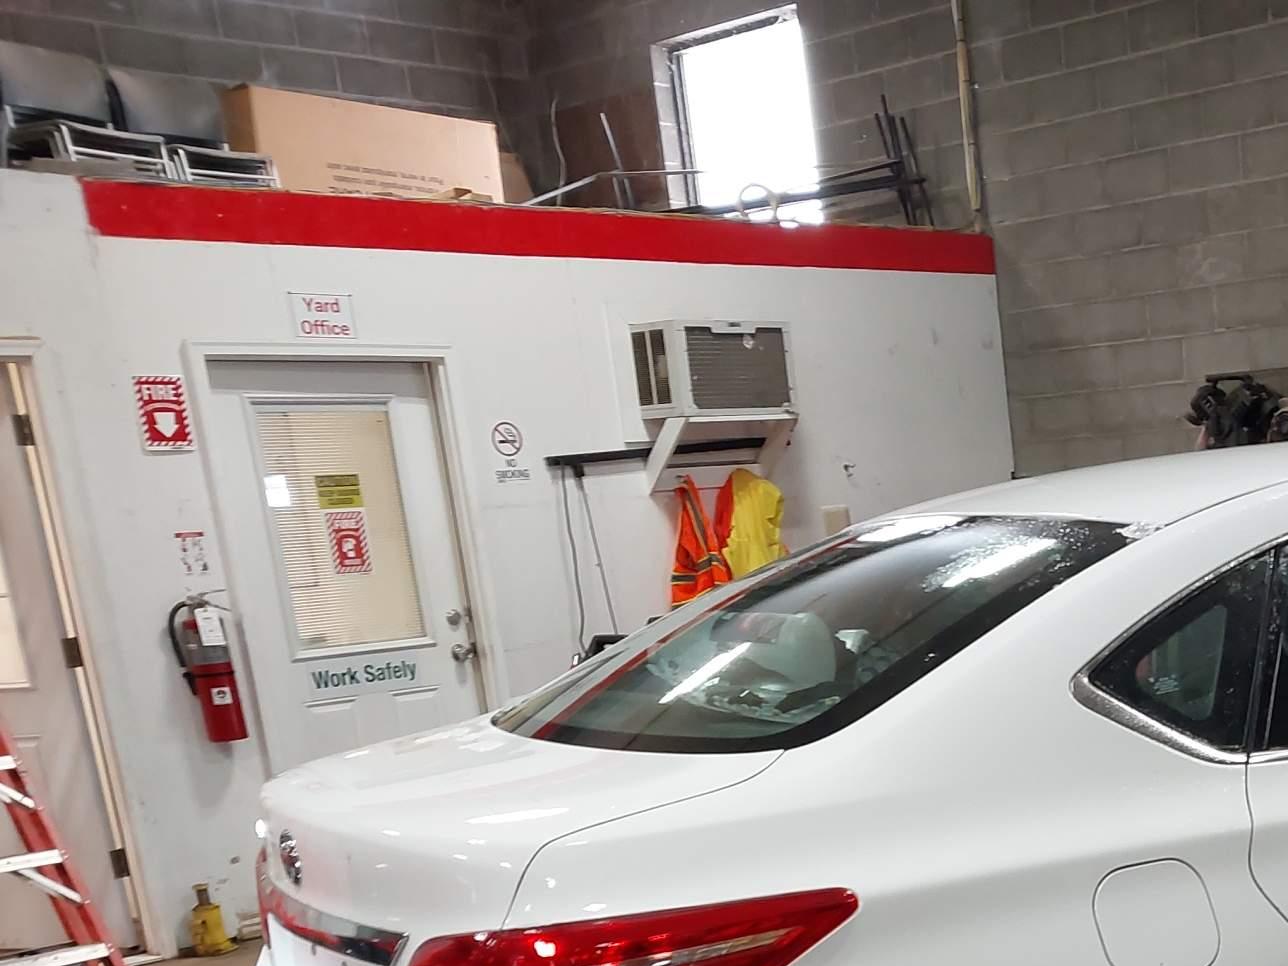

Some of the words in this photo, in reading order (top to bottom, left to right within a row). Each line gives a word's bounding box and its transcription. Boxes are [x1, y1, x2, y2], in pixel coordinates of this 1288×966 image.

[302, 297, 340, 313] Yard
[301, 319, 350, 336] Office
[140, 384, 179, 401] FIRE
[311, 667, 360, 690] Work
[363, 660, 417, 683] Safely
